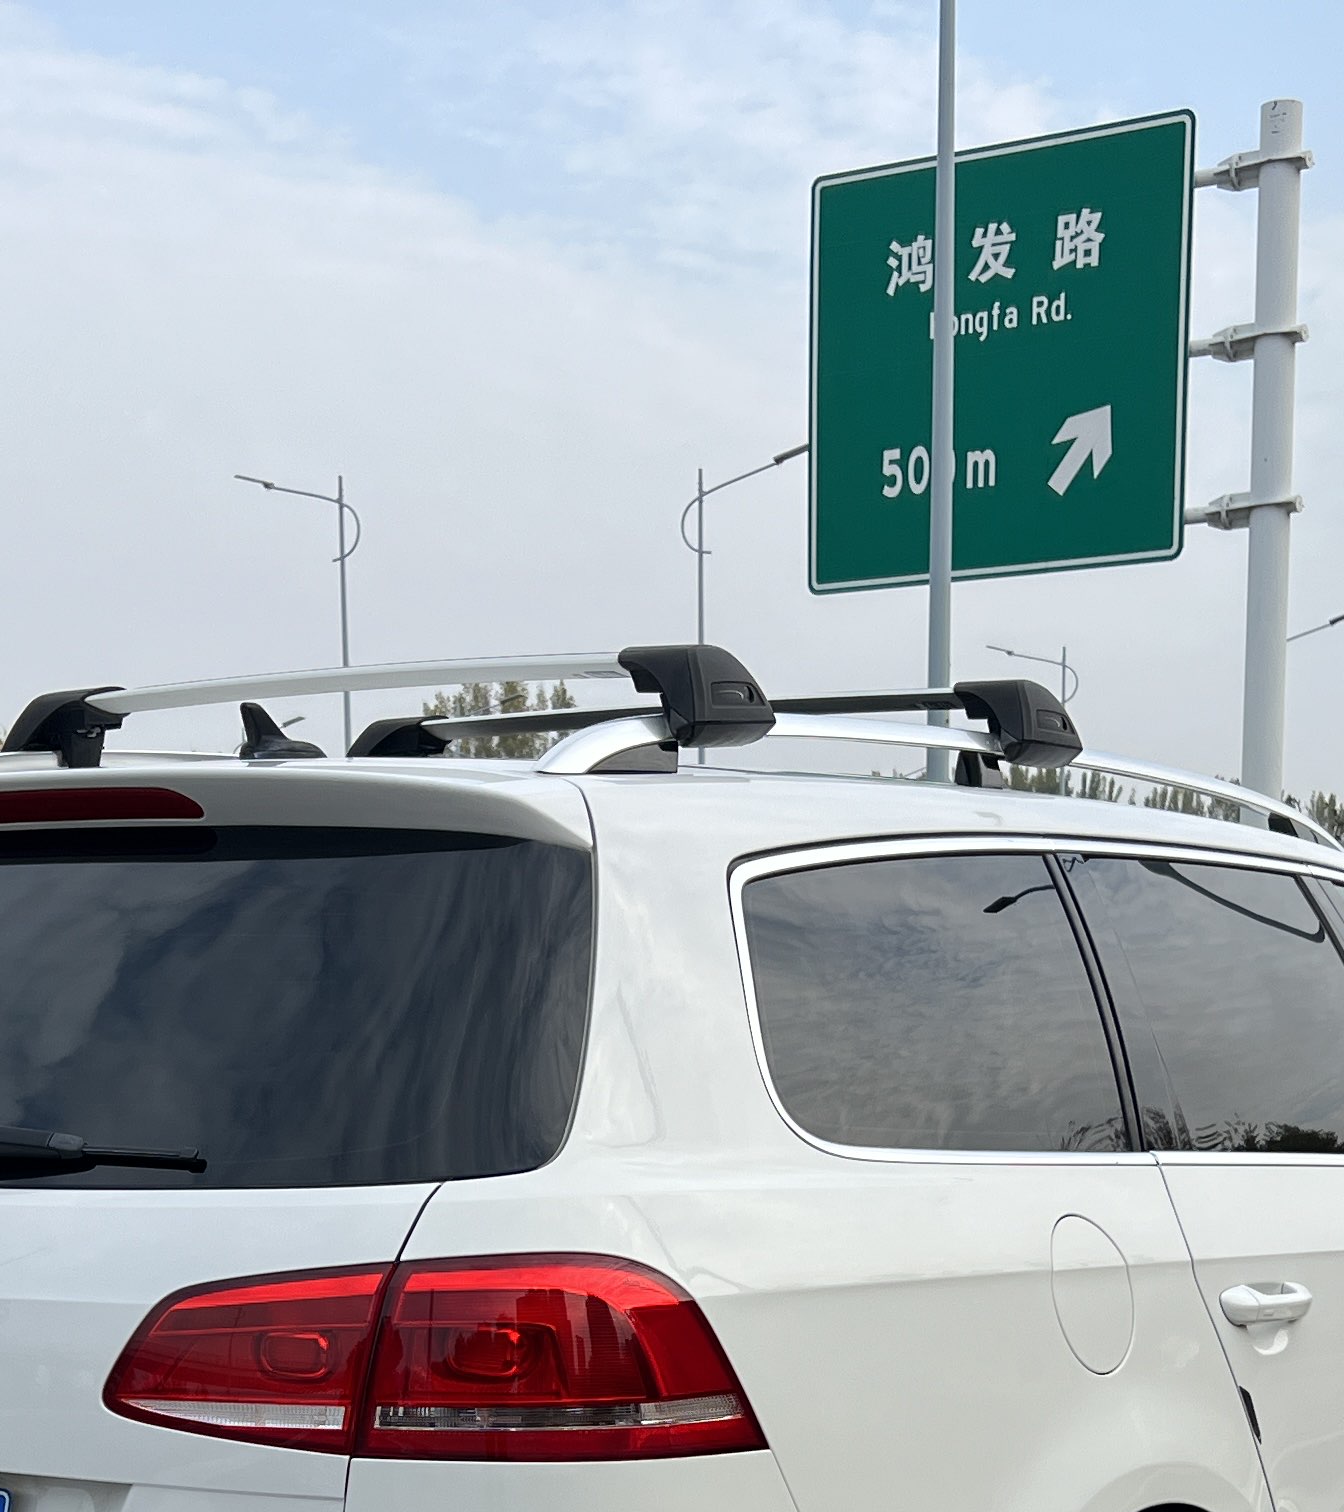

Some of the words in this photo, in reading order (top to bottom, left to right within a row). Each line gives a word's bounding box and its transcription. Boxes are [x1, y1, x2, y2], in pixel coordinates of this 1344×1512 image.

[886, 208, 1105, 297] 鸿发路
[929, 301, 1019, 342] ngfa
[1031, 291, 1072, 325] Rd.
[882, 445, 956, 498] 50
[966, 448, 996, 489] m
